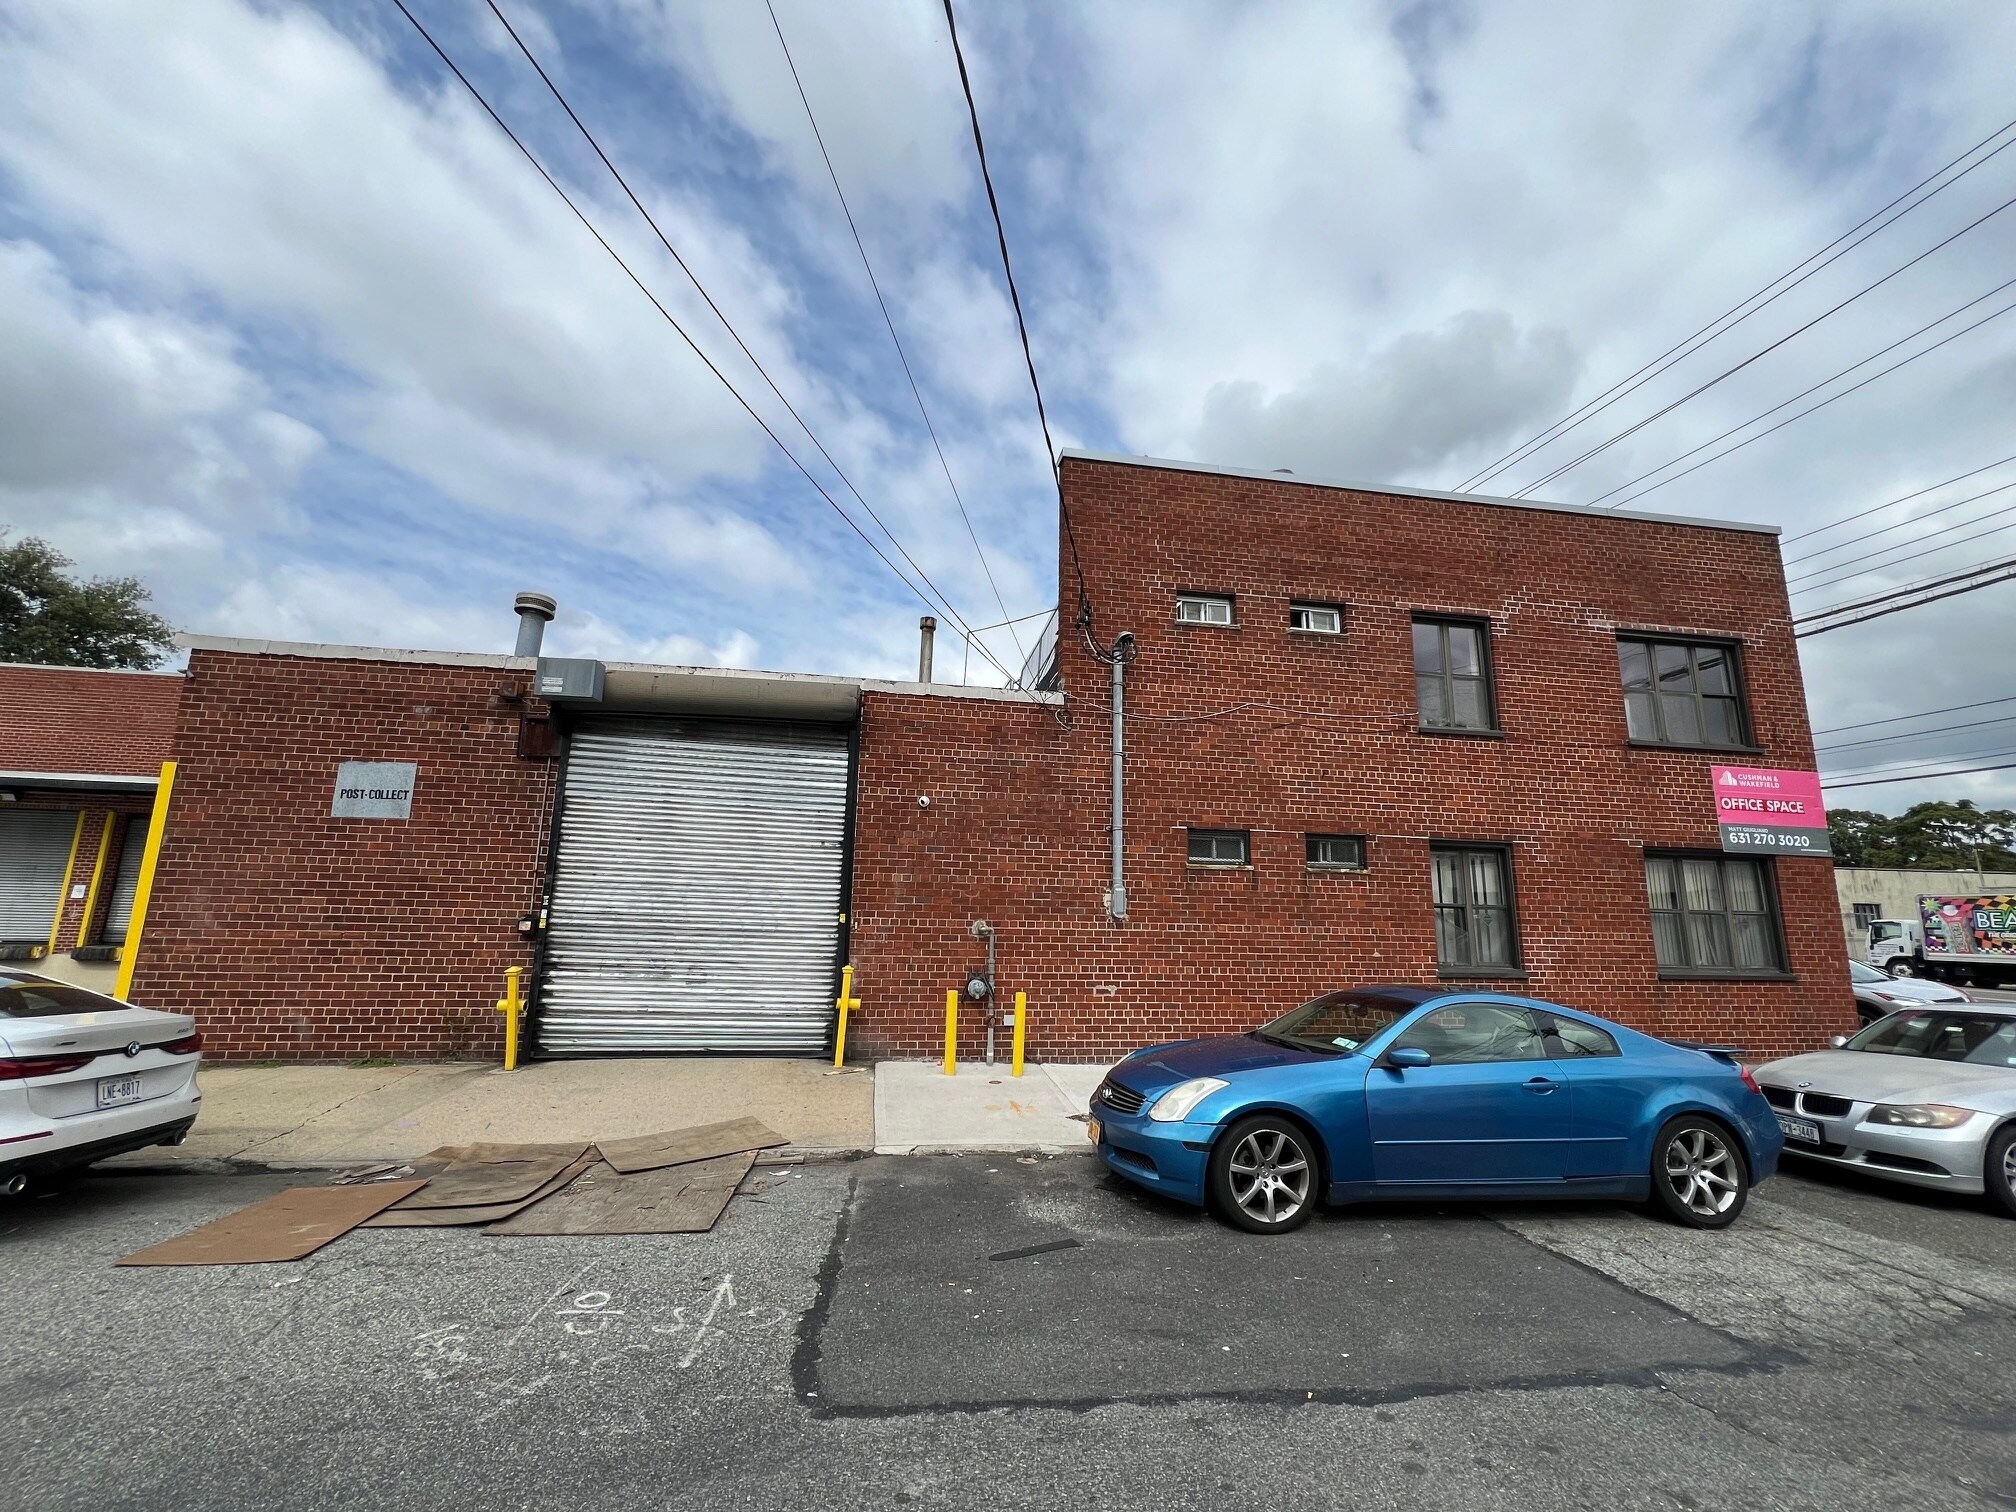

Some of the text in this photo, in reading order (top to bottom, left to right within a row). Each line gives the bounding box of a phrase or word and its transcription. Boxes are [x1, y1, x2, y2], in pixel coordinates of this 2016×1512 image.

[1738, 774, 1772, 782] CUSHMAN
[1739, 780, 1780, 789] WAKEFIELD
[1721, 797, 1804, 813] OFFICE SPACE
[1729, 832, 1810, 847] 631 270 3020
